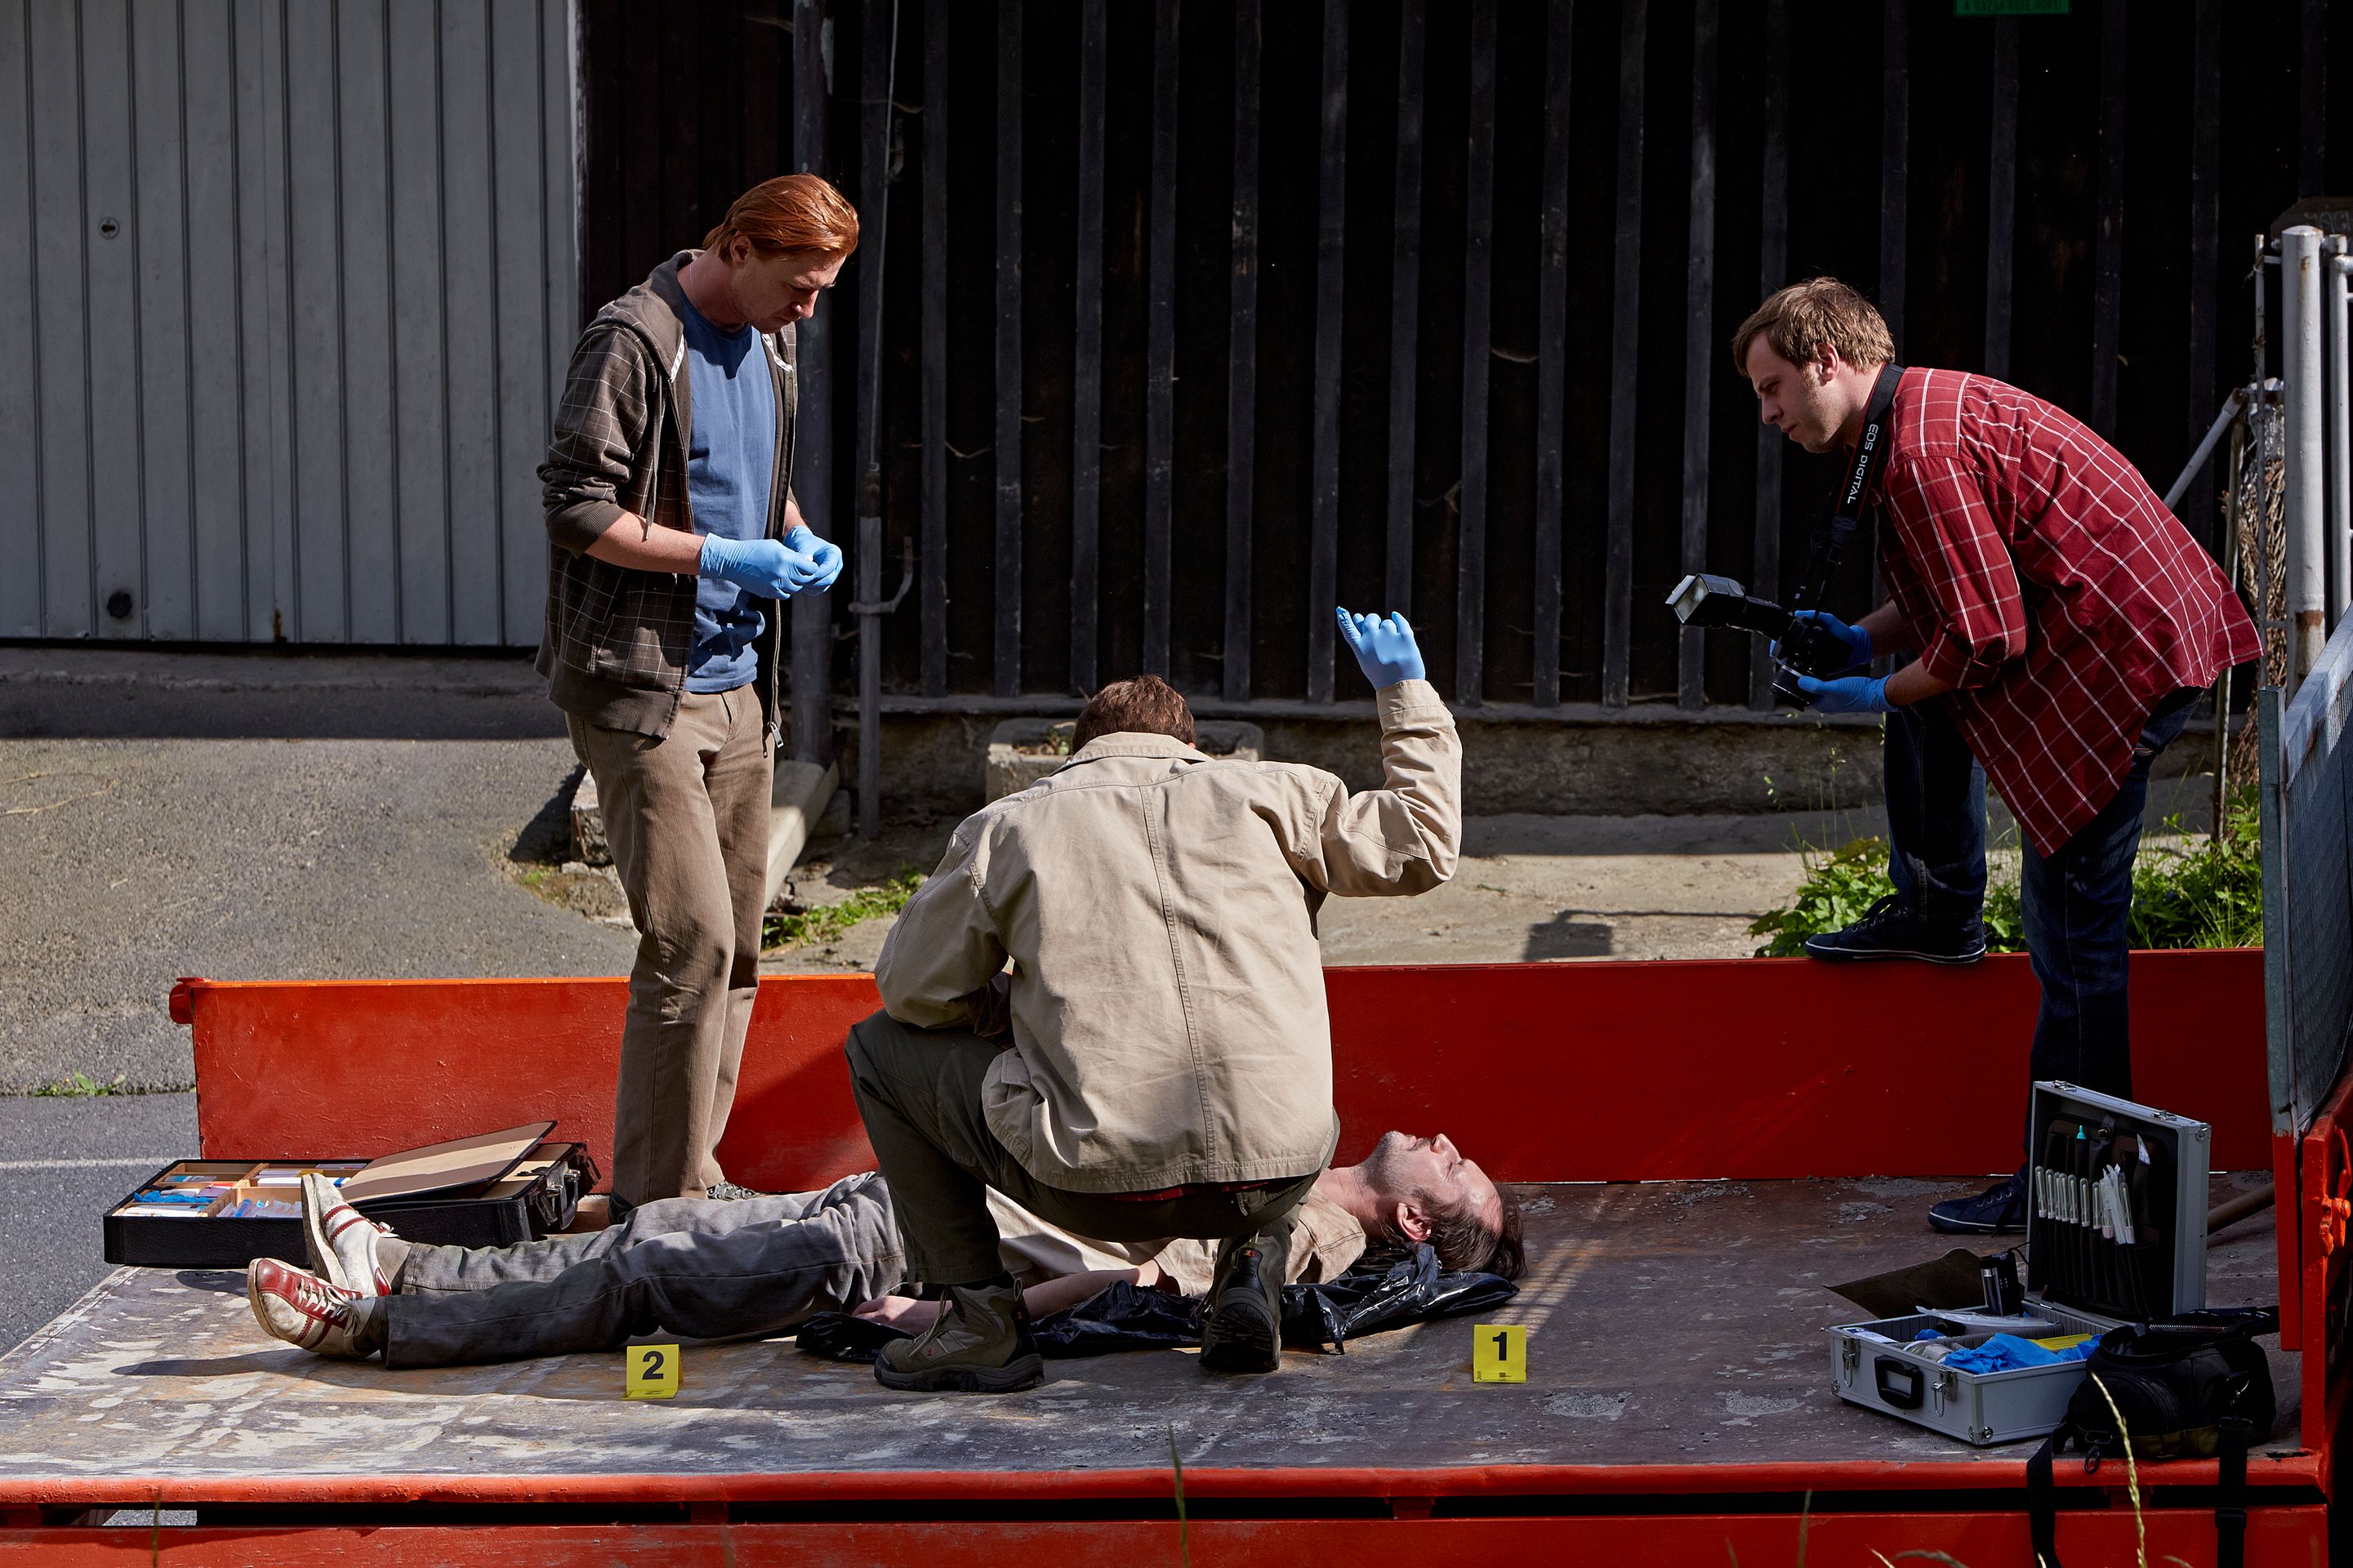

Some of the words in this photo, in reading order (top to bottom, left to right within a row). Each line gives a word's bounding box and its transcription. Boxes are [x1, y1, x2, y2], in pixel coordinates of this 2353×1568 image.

[1865, 424, 1878, 451] EOS
[1847, 455, 1868, 504] DIGITAL
[1492, 1332, 1507, 1361] 1
[642, 1351, 664, 1380] 2
